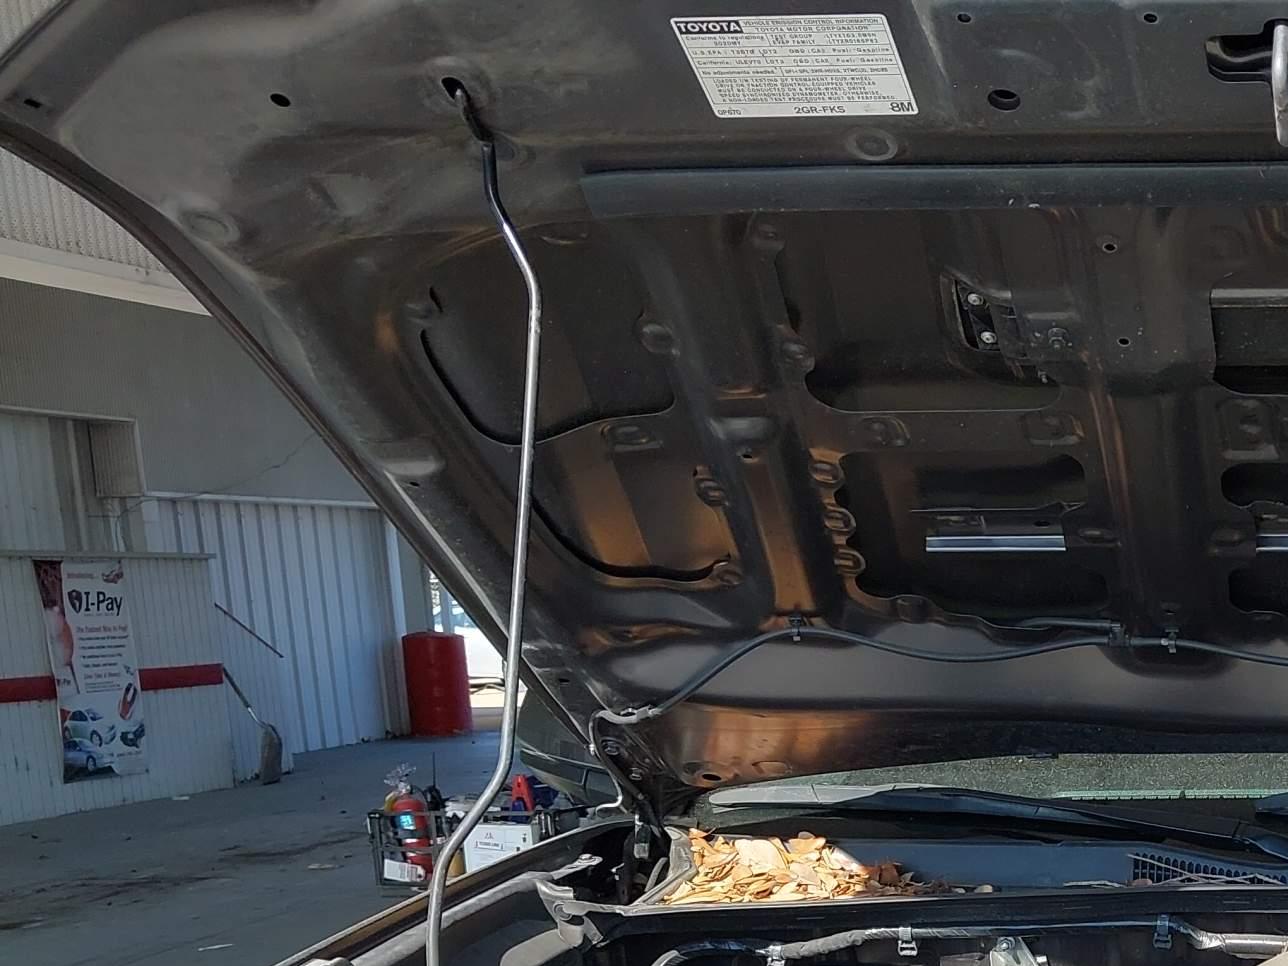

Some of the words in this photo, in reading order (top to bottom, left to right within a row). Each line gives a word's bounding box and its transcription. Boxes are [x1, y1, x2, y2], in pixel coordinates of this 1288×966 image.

[676, 21, 742, 33] TOYOTA
[793, 106, 846, 114] 2GR-FKS
[889, 101, 915, 112] 8M
[84, 591, 123, 616] I-Pay
